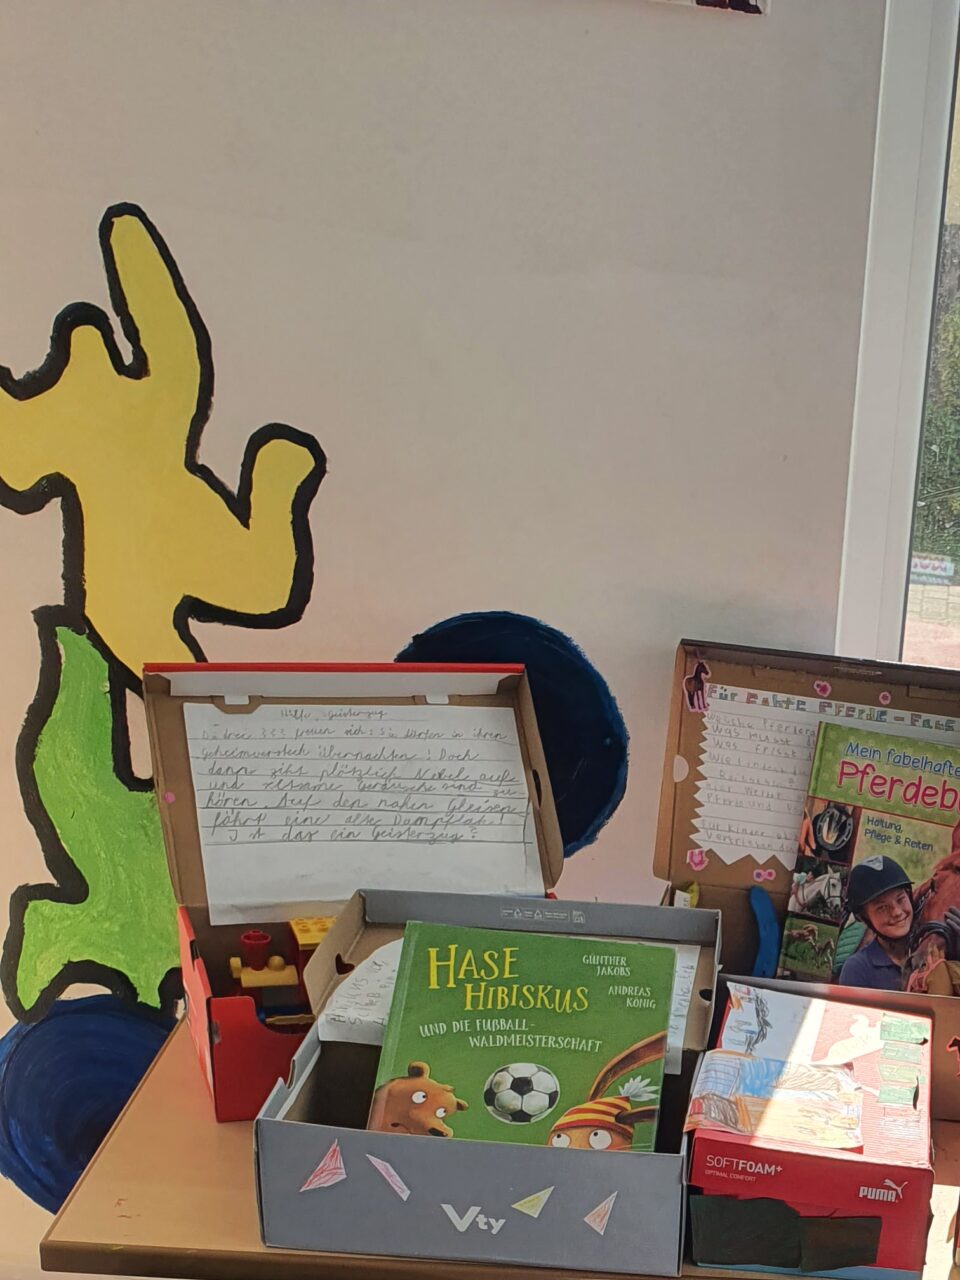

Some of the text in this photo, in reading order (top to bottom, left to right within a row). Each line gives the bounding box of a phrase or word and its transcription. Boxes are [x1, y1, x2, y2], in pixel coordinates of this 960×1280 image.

[846, 742, 882, 759] Mein
[864, 828, 893, 845] Pflege
[904, 838, 934, 852] Reiten
[428, 944, 519, 990] HASE
[596, 965, 631, 977] JAKOBS
[464, 982, 589, 1013] HIBISKUS
[608, 985, 652, 997] ANDREAS
[626, 996, 656, 1009] KÖNIG
[419, 1022, 447, 1038] UND
[452, 1019, 471, 1033] DIE
[469, 1034, 603, 1053] WALDMEISTERSCHAFT
[706, 1155, 783, 1176] SOFTFOAM+
[729, 1173, 757, 1183] COMFORT
[859, 1186, 897, 1202] PUMA
[440, 1203, 506, 1235] Vty
